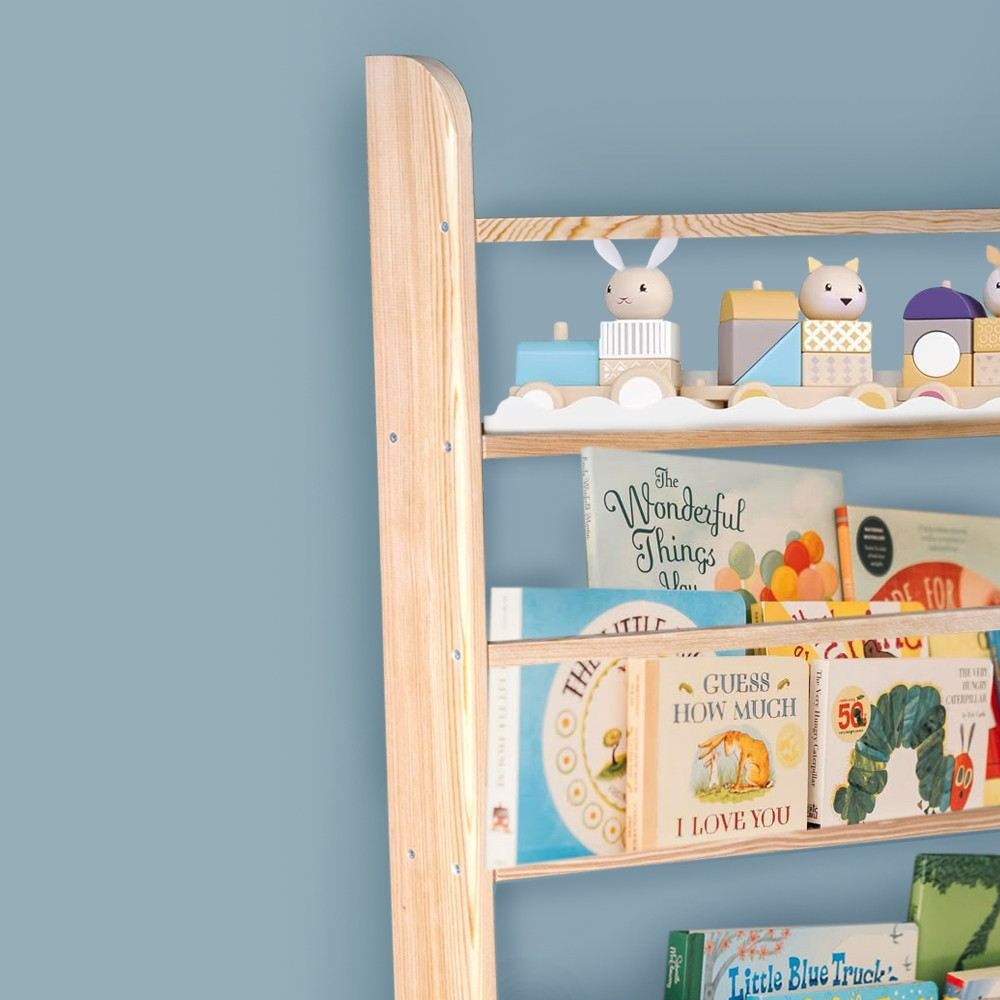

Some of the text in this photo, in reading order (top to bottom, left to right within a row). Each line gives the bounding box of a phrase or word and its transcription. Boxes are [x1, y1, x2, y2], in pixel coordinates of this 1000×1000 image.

[655, 467, 679, 489] The
[604, 482, 746, 537] Wonderful
[632, 527, 716, 575] Things
[703, 672, 770, 694] GUESS
[673, 697, 797, 724] HOW MUCH
[810, 711, 821, 741] Hungry
[810, 744, 818, 787] Caterpillar
[676, 818, 683, 837] I
[692, 811, 746, 836] LOVE
[750, 806, 791, 828] YOU
[788, 956, 829, 992] Blue
